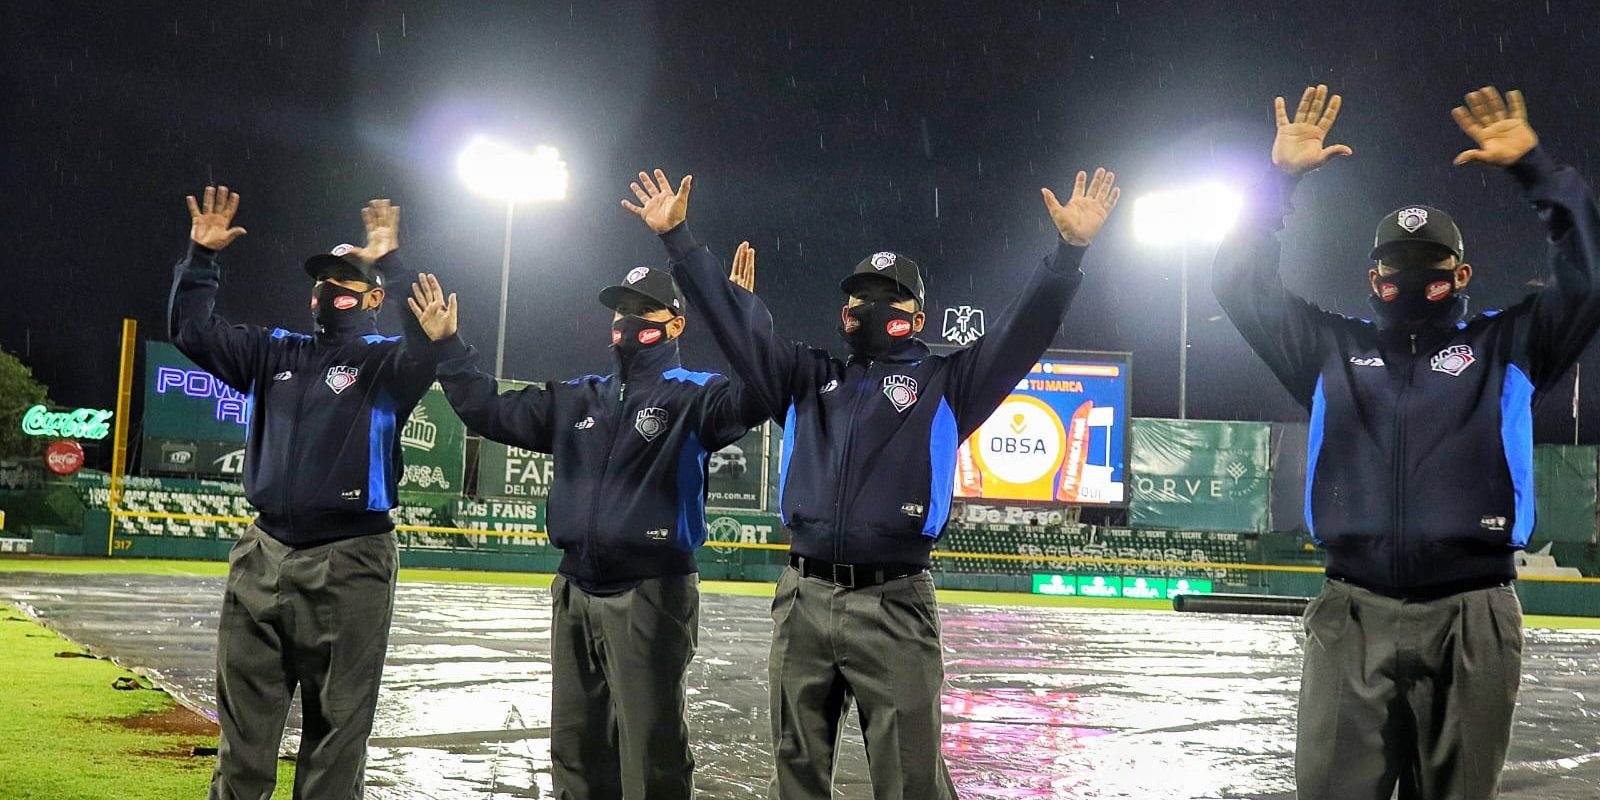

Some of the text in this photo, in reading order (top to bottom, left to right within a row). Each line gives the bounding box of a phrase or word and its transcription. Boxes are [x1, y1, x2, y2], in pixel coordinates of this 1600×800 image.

[1431, 345, 1473, 366] LMB
[329, 366, 358, 376] LMB
[157, 367, 248, 401] POW
[883, 375, 917, 393] LMB
[1045, 381, 1084, 392] MARCA
[637, 408, 668, 423] LMB
[991, 437, 1047, 454] OBSA
[504, 485, 551, 497] DEL MA
[458, 501, 537, 519] LOS FANS
[114, 540, 132, 550] 317
